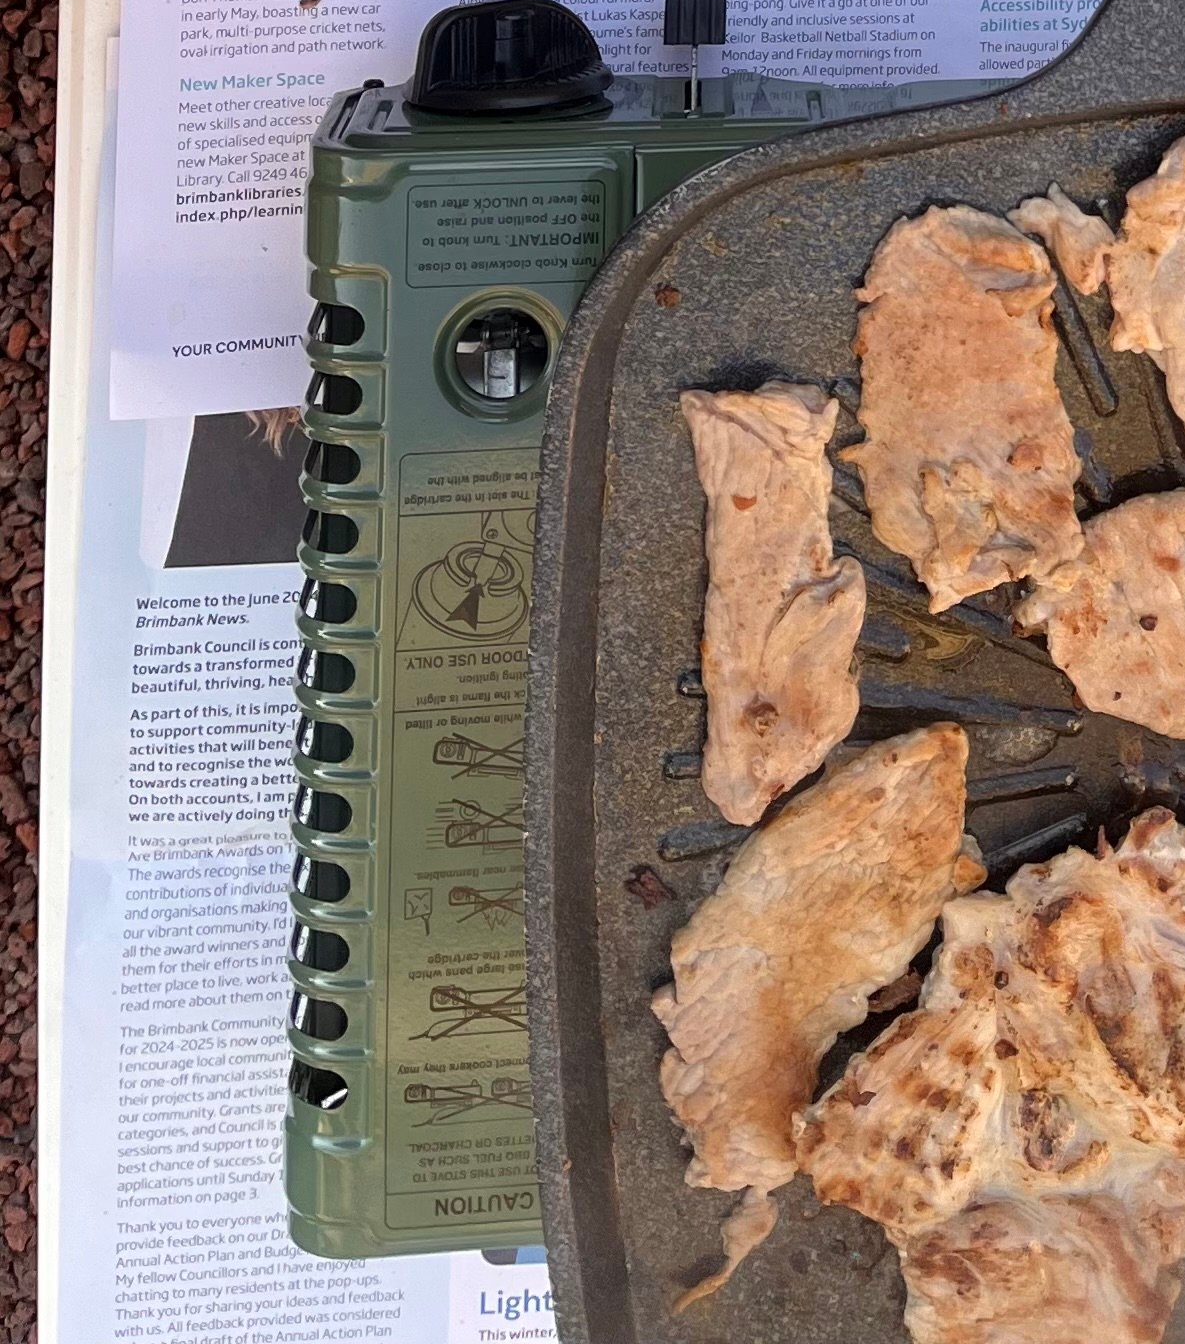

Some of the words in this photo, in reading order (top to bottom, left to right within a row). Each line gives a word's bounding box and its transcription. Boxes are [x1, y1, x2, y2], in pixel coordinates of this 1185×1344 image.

[180, 78, 217, 91] New
[222, 74, 272, 88] Maker
[276, 72, 324, 88] Space
[441, 199, 468, 208] after
[472, 196, 527, 208] UNLOCK
[531, 196, 543, 205] to
[548, 194, 577, 203] lever
[581, 193, 599, 203] the
[422, 237, 434, 247] to
[438, 236, 468, 247] knob
[473, 235, 500, 245] Turn
[505, 232, 599, 247] IMPORTANT:
[172, 343, 212, 358] YOUR
[136, 597, 200, 609] Welcome
[204, 595, 218, 607] to
[221, 593, 245, 605] the
[247, 593, 279, 607] June
[136, 614, 203, 628] Brimbank
[206, 613, 248, 625] News.
[448, 653, 476, 667] USE
[434, 1191, 534, 1216] CAUTION
[480, 1288, 555, 1320] Light
